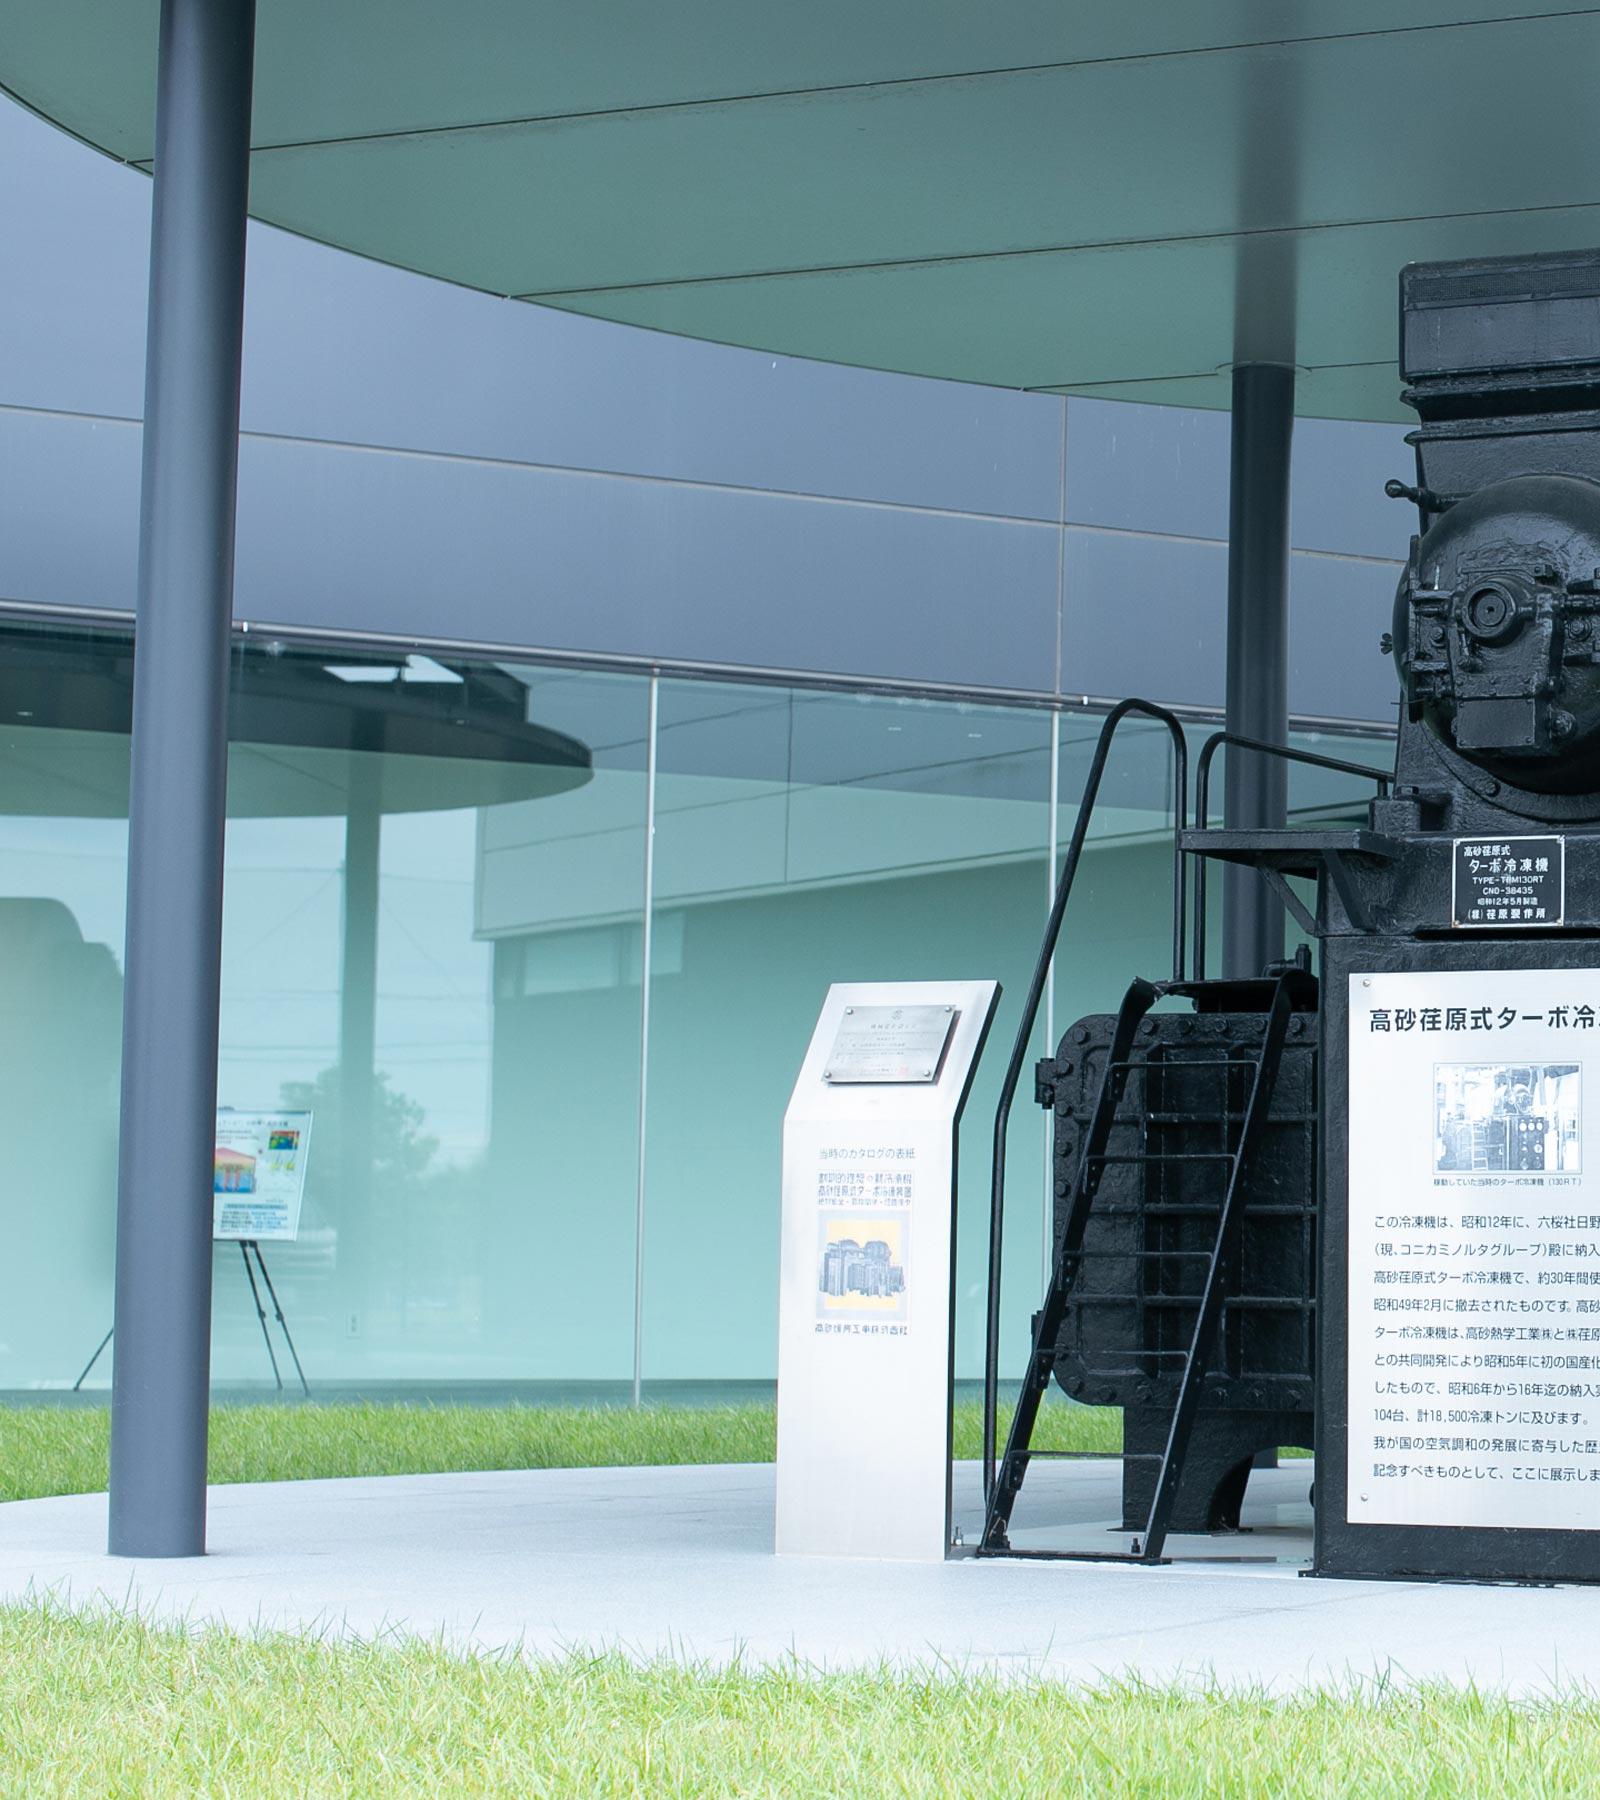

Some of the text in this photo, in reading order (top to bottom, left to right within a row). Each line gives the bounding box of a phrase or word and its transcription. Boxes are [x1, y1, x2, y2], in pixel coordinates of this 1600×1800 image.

[1463, 844, 1511, 857] 高砂荏原式
[1469, 857, 1549, 873] ターボ冷凍機
